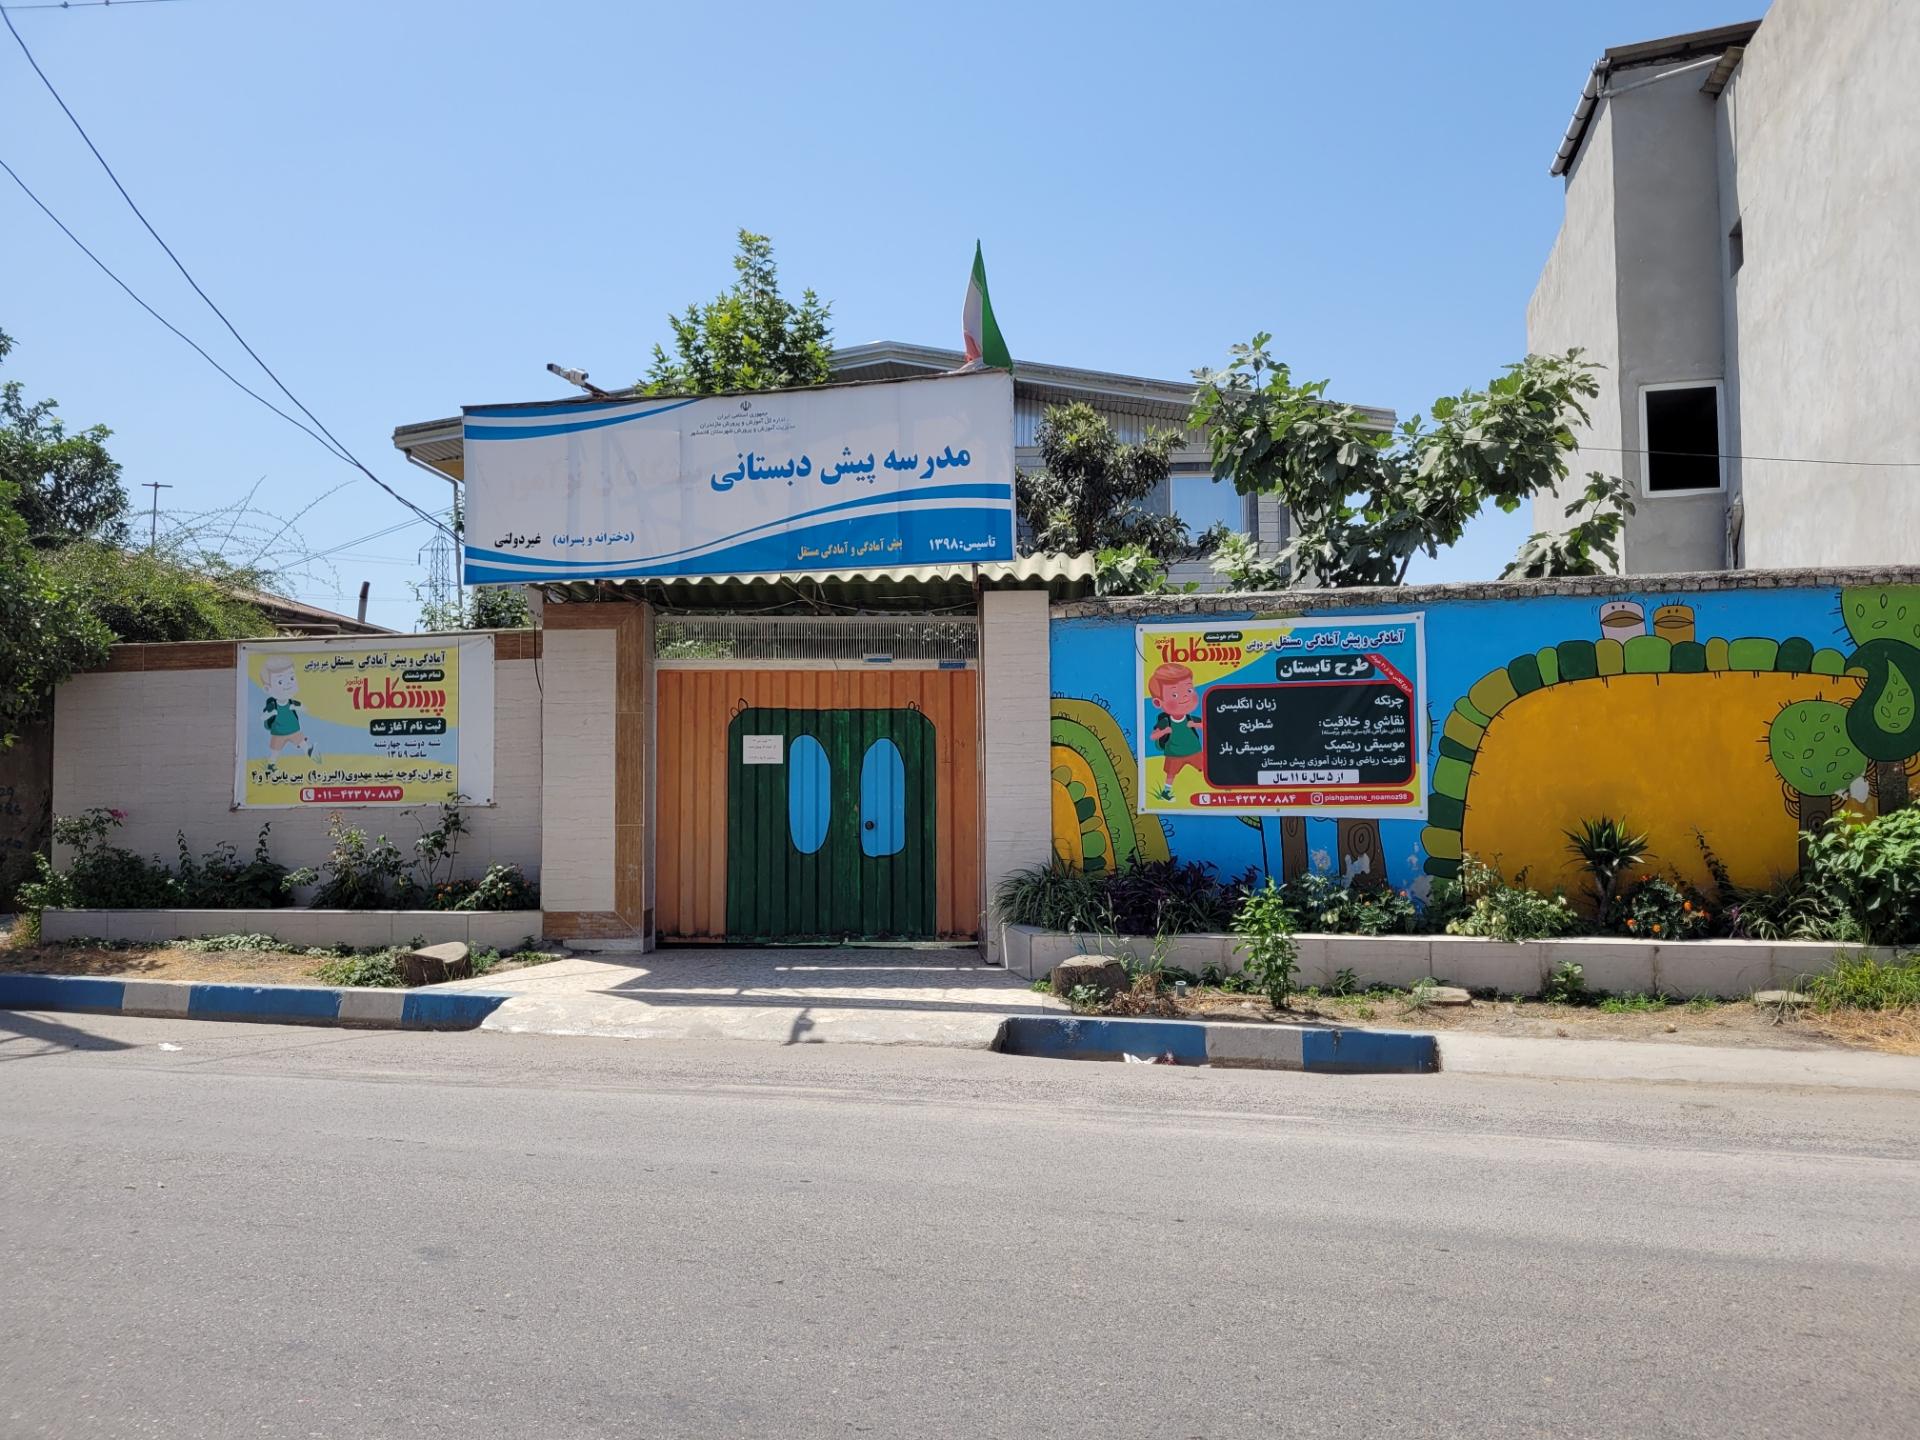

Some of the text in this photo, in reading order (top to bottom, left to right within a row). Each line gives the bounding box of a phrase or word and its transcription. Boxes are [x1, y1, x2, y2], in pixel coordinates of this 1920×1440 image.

[711, 446, 971, 492] مدرسه پیش دبستانی
[588, 536, 593, 546] و
[857, 538, 884, 556] آمادگی
[821, 541, 849, 559] آمادگی
[850, 546, 856, 557] و
[1275, 634, 1302, 650] مستقل
[1305, 631, 1340, 650] آمادگی
[1341, 631, 1362, 649] پیش
[1370, 628, 1405, 647] آمادگی
[358, 653, 388, 668] آمادگی
[415, 650, 445, 667] آمادگی
[1280, 657, 1370, 678] طرح تابستان
[1216, 696, 1277, 713] زبان انگلیسی
[1374, 694, 1404, 709] چرتکه
[372, 719, 442, 734] ثبت نام آغاز شد
[1239, 718, 1274, 734] شطرنج
[1363, 720, 1371, 729] و
[1373, 715, 1405, 729] نقاشی
[1219, 741, 1275, 755] موسیقی بلز
[1324, 738, 1405, 753] موسیقی ریتمیک
[1261, 754, 1406, 769] تقویت ریاضی و زبان آموزی پیش دبستانی
[374, 769, 394, 780] شهید
[1273, 771, 1344, 784] از ۵ سال تا ۱۱ سال
